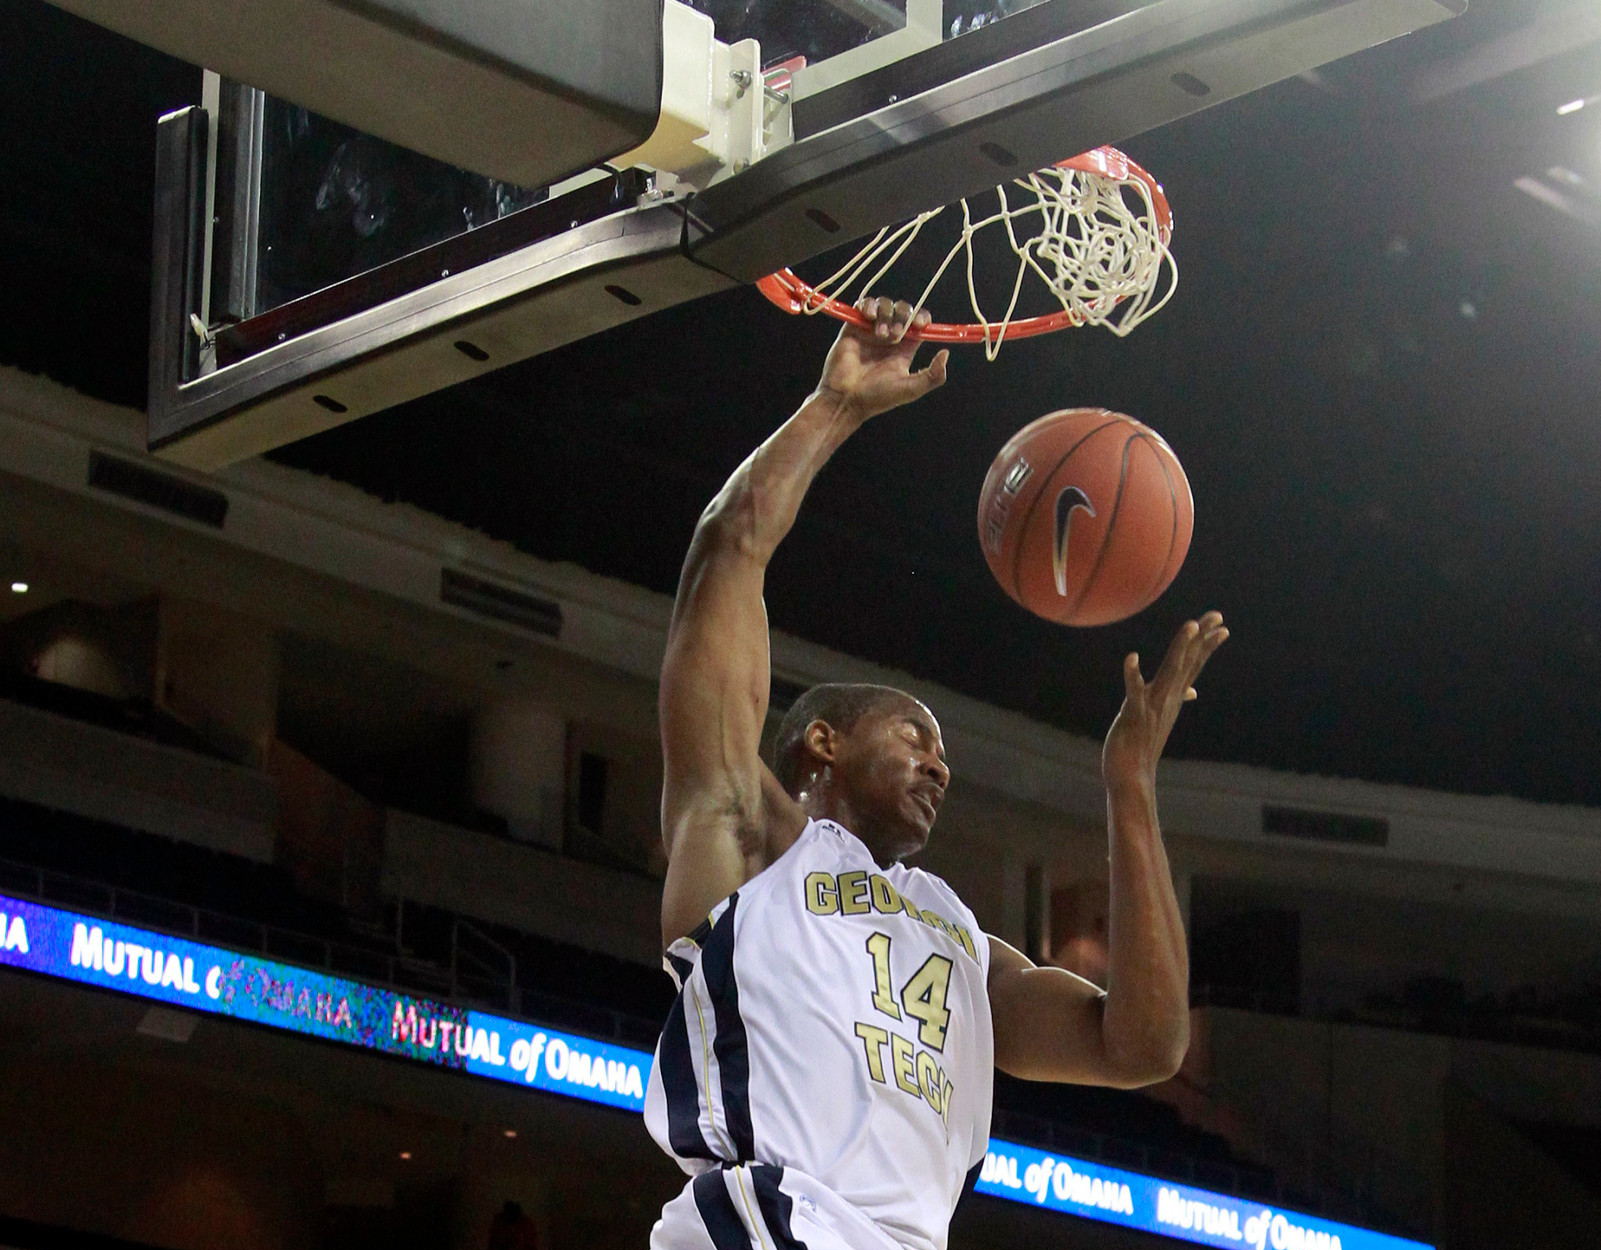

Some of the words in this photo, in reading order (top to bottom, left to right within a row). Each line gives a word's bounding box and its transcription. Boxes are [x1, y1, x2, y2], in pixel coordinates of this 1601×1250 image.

[70, 922, 200, 994] MUTUAL
[866, 931, 954, 1053] 14
[390, 1000, 505, 1066] MUTUAL
[510, 1032, 547, 1083] of
[545, 1038, 644, 1099] OMAHA
[1024, 1157, 1055, 1204] of
[1053, 1161, 1134, 1216] OMAHA
[1157, 1187, 1243, 1241] MUTUAL
